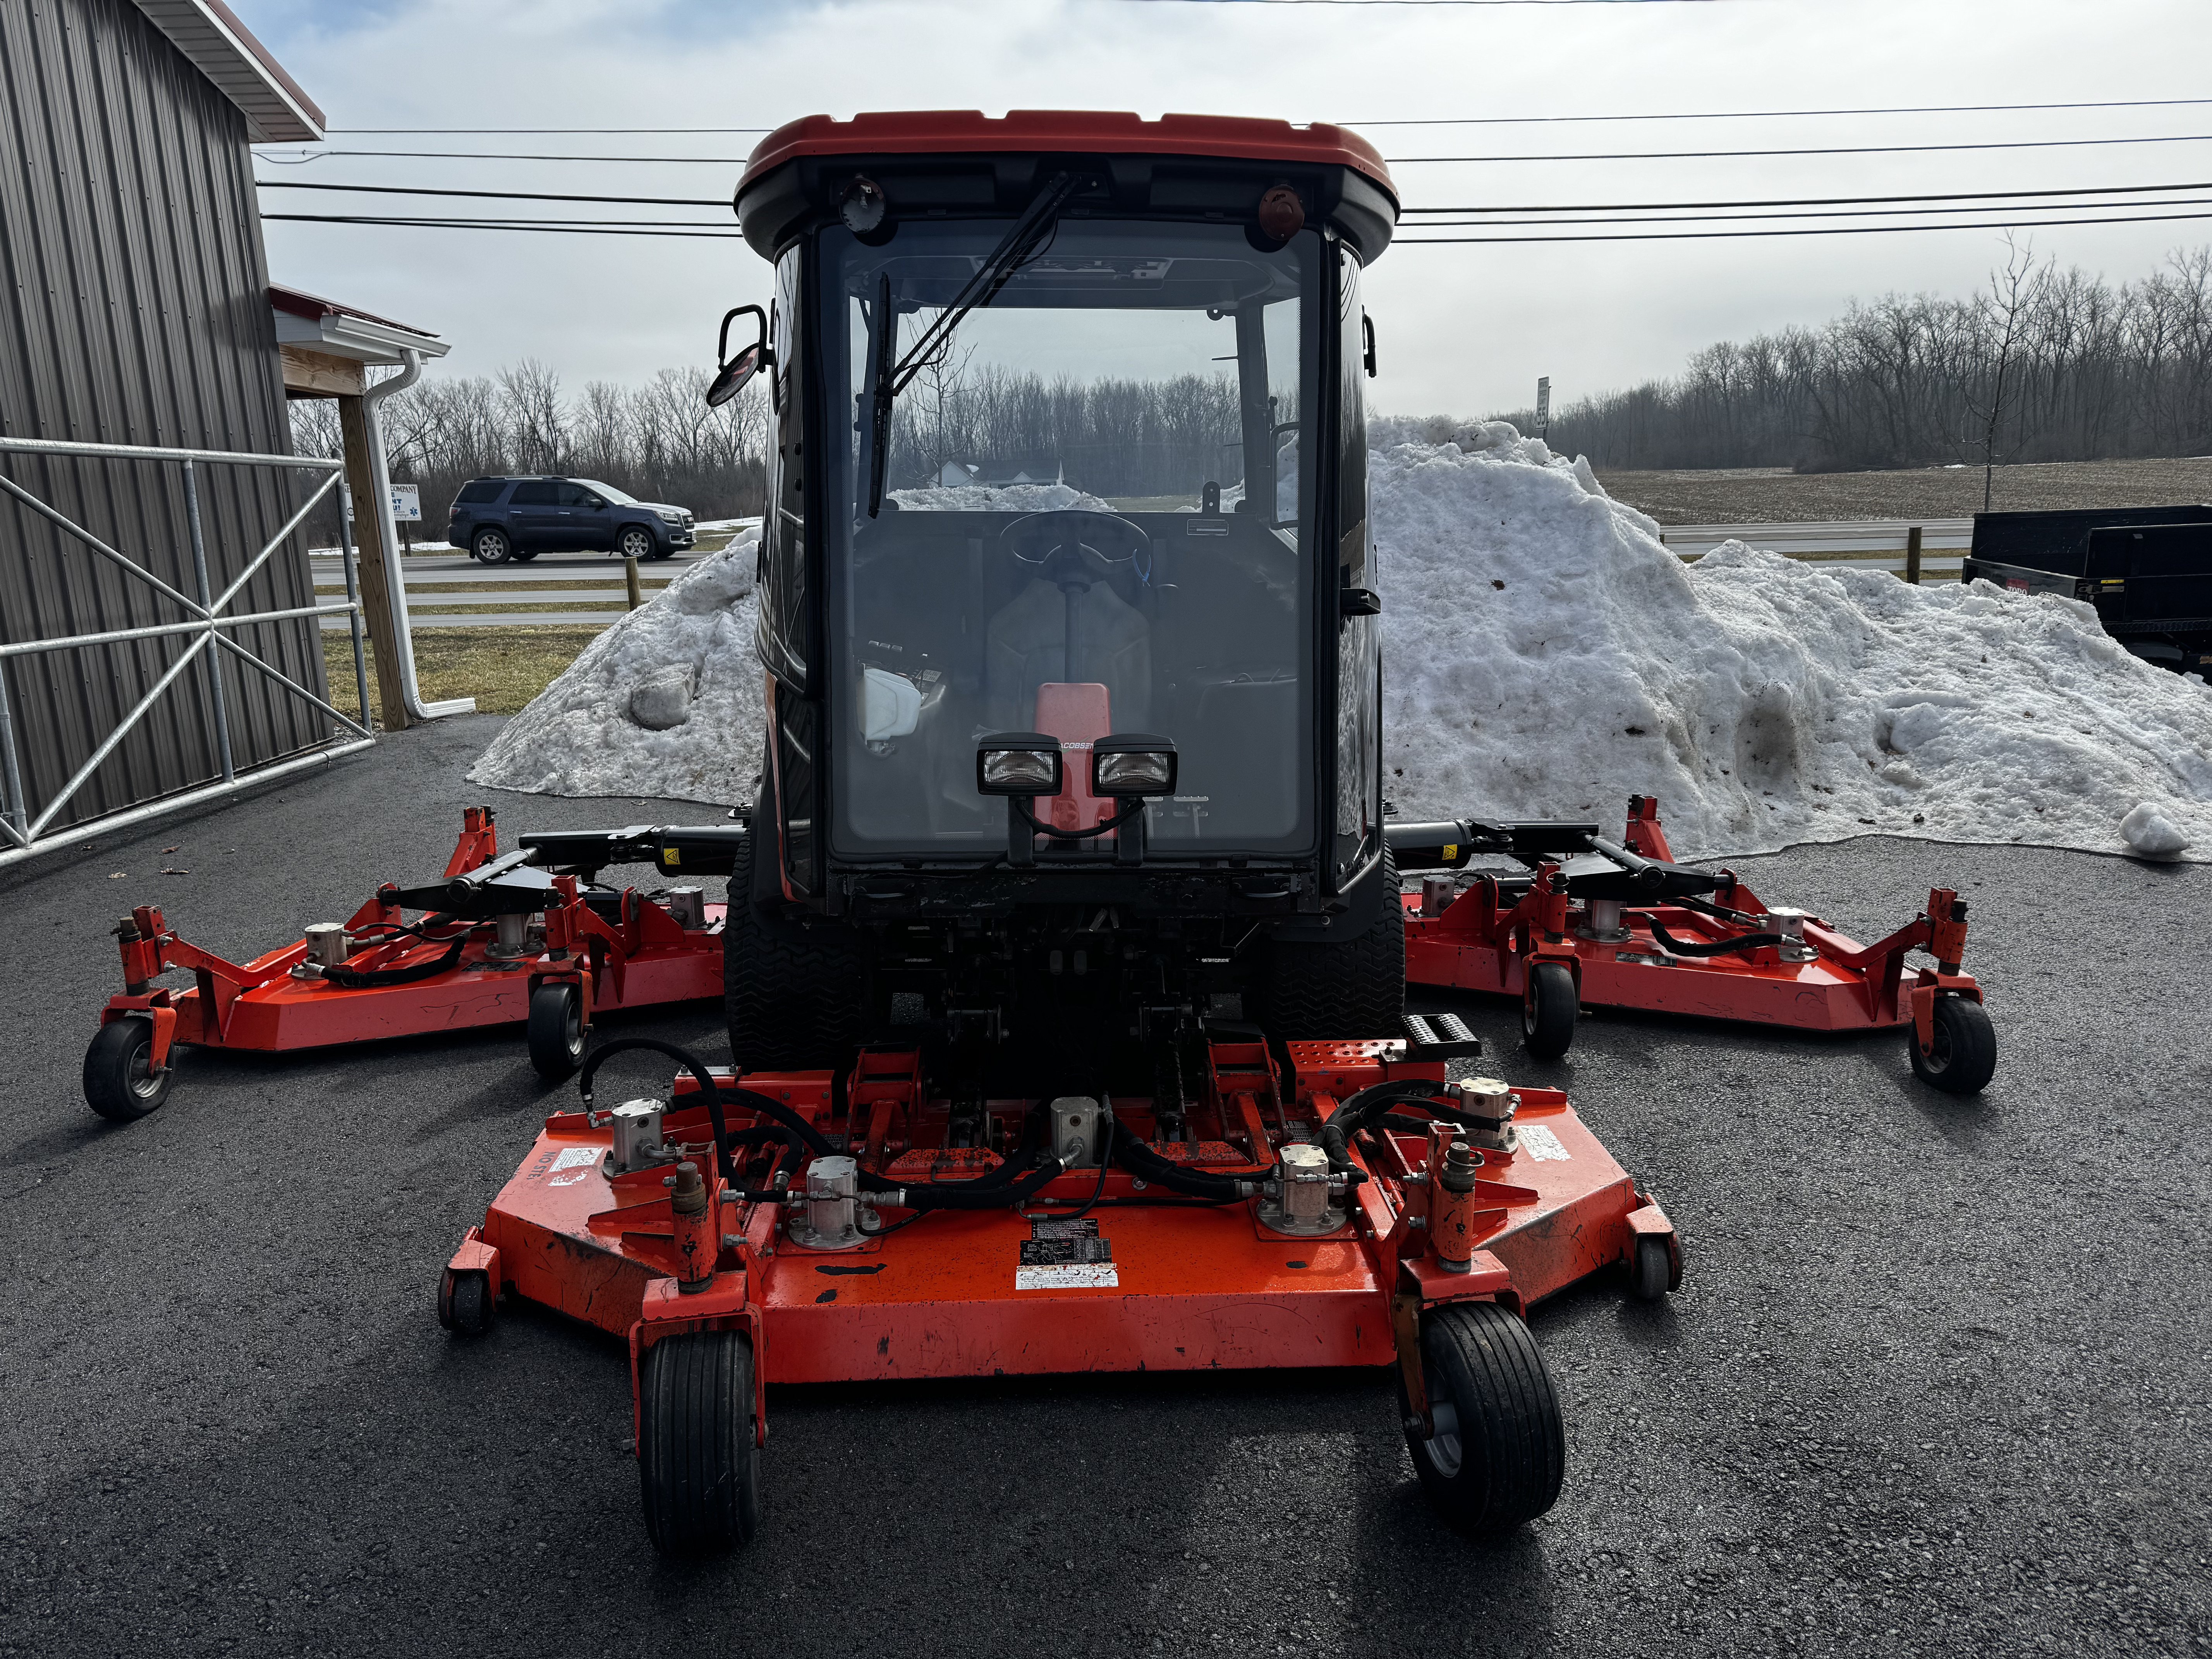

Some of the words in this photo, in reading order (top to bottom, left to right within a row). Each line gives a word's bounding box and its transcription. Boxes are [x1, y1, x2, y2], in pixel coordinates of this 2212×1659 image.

[1537, 407, 1546, 426] 55
[390, 486, 416, 494] COMPANY
[539, 1151, 556, 1164] NO
